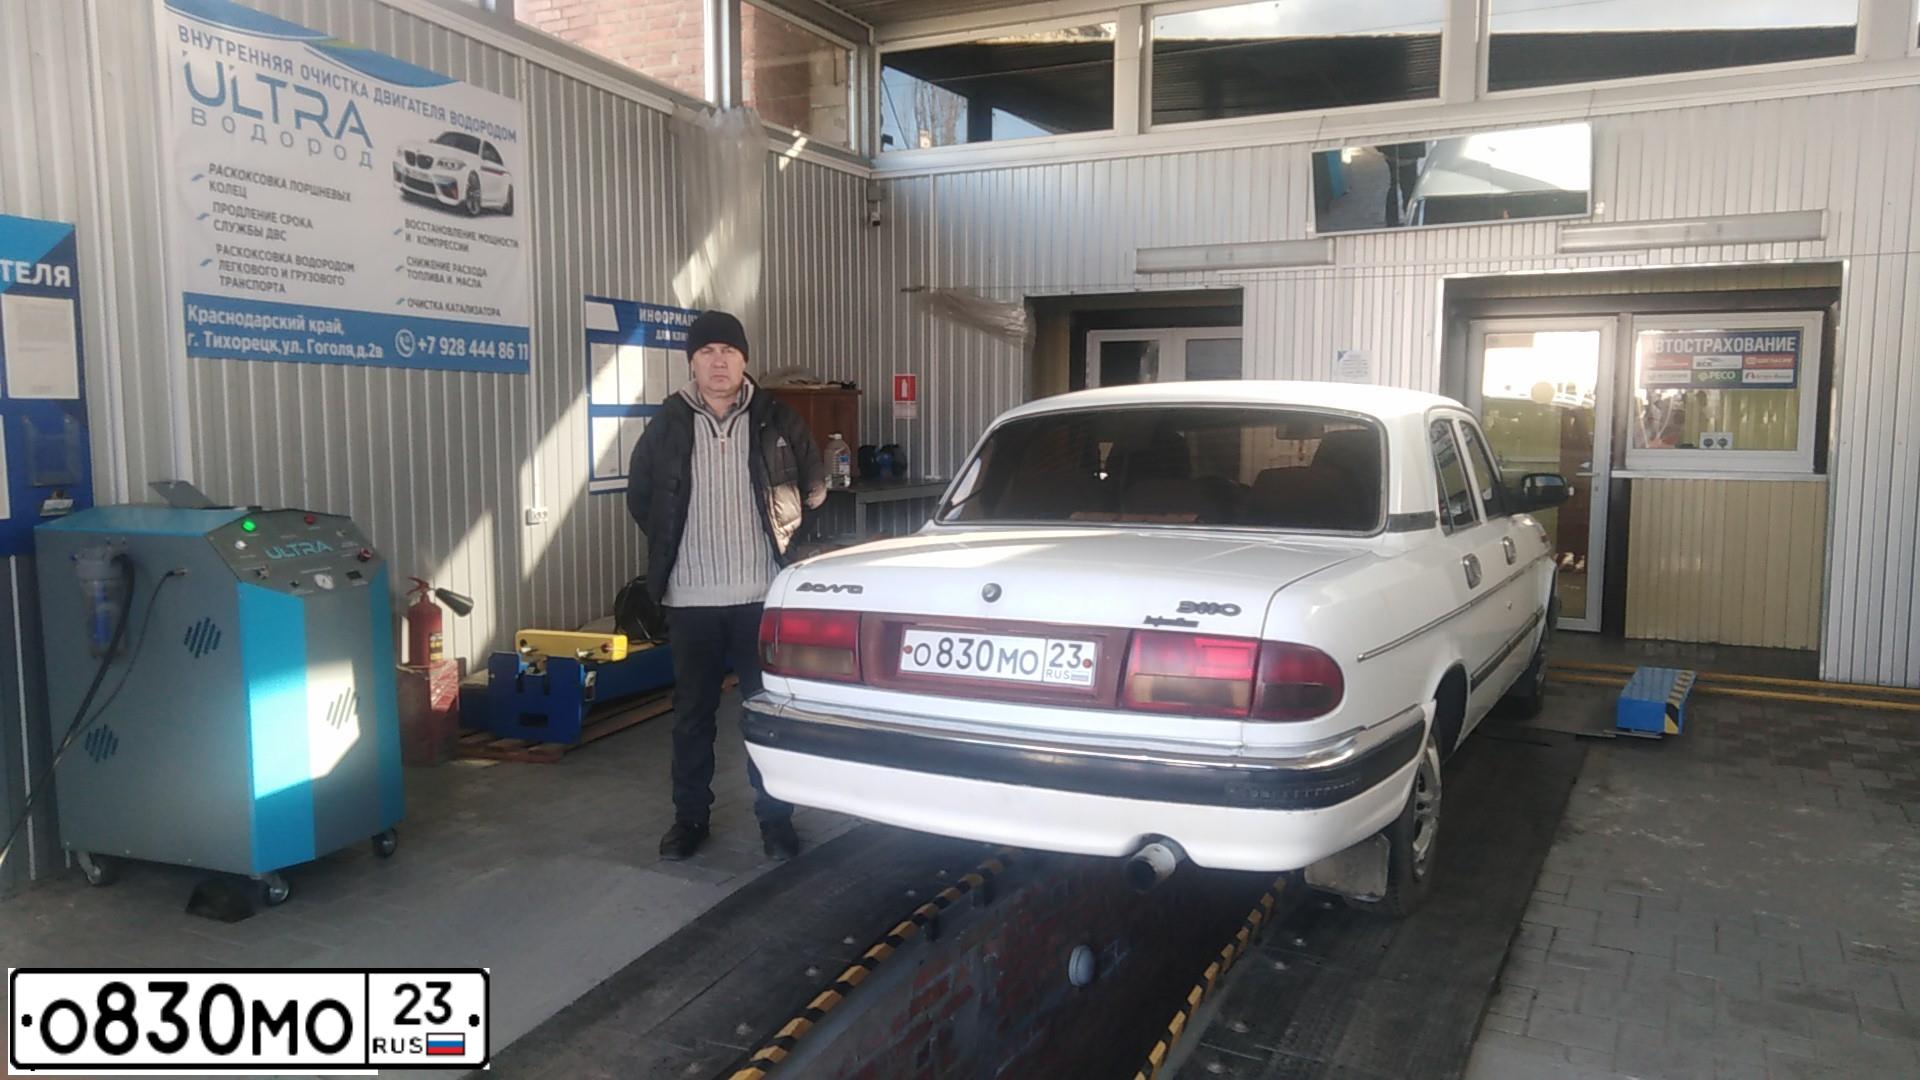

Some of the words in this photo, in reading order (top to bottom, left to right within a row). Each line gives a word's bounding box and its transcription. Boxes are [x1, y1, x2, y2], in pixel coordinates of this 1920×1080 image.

[178, 24, 294, 76] ВНУТРЕННЯЯ
[300, 64, 369, 98] ОЧИСТКА
[373, 87, 447, 121] ДВИГАТЕЛЯ
[450, 110, 517, 142] ВОДОРОДОМ
[183, 58, 374, 149] ULTRA
[209, 163, 287, 189] РАСКОКСОВКА
[290, 180, 351, 202] ПОРШНЕВЫХ
[209, 181, 248, 199] КОЛЕЦ
[213, 202, 278, 223] ПРОДЛЕНИЕ
[280, 214, 314, 229] СРОКА
[214, 220, 263, 237] СЛУЖБЫ
[266, 229, 287, 241] ДВС
[405, 218, 476, 240] ВОССТАНОВЛЕНИЕ
[405, 233, 412, 242] И
[417, 236, 469, 252] КОМПРЕССИИ
[216, 244, 293, 264] РАСКОКСОВКА
[296, 255, 355, 273] ВОДОРОДОМ
[406, 256, 450, 272] СНИЖЕНИЕ
[453, 263, 487, 277] РАСХОДА
[219, 260, 279, 277] ЛЕГКОВОГО
[281, 269, 288, 279] И
[291, 270, 345, 286] ГРУЗОВОГО
[407, 269, 445, 284] ТОПЛИВА
[456, 277, 482, 288] МАСЛА
[219, 276, 286, 293] ТРАНСПОРТА
[188, 304, 305, 331] Краснодарский
[407, 298, 443, 311] ОЧИСТКА
[445, 302, 501, 317] КАТАЛИЗАТОРА
[639, 308, 698, 327] ИНФОРМАЦ
[418, 336, 435, 353] +7
[440, 338, 465, 357] 928
[469, 339, 495, 358] 444
[498, 341, 514, 360] 86
[518, 343, 529, 361] 11
[265, 541, 333, 559] ULTRA
[1049, 643, 1083, 669] 23
[1045, 669, 1070, 680] RUS
